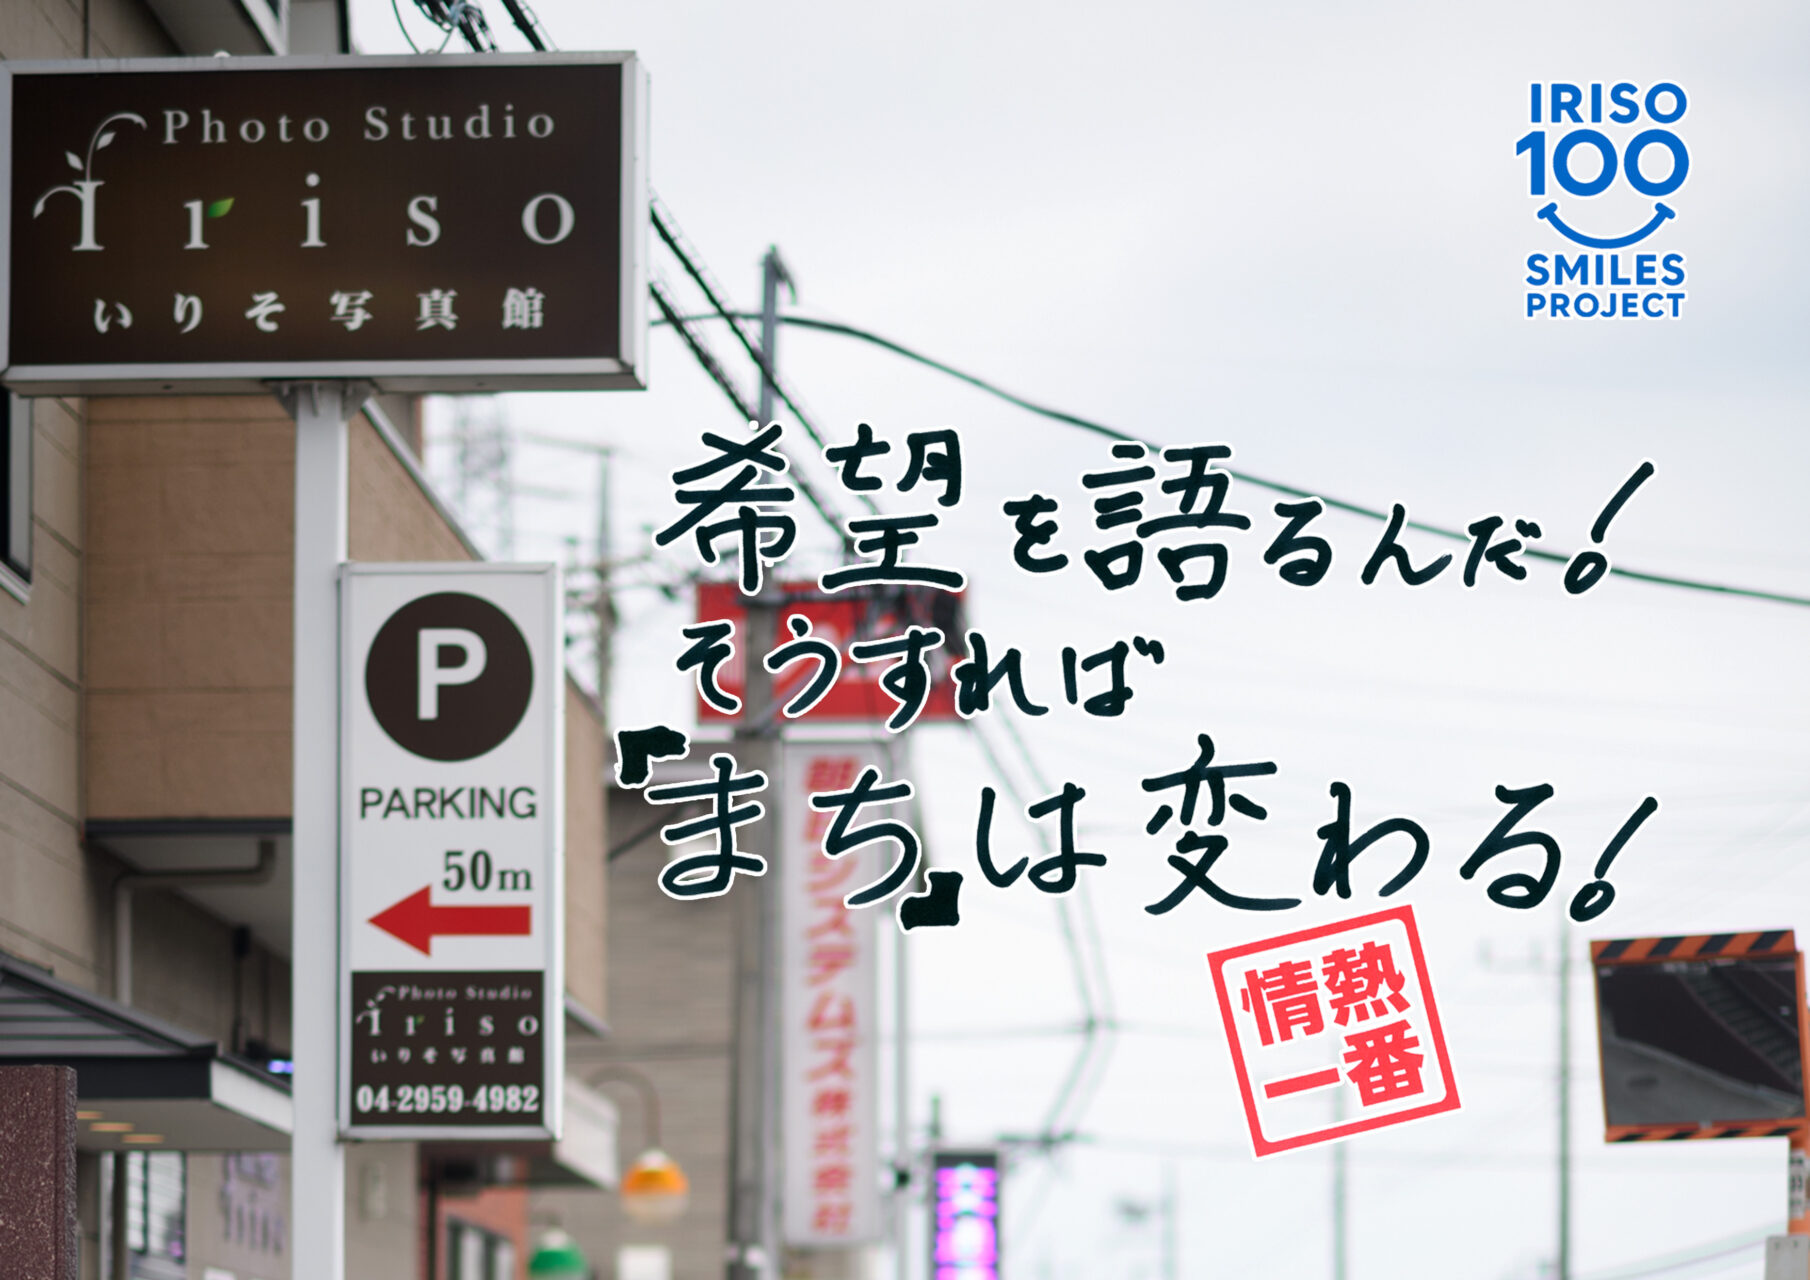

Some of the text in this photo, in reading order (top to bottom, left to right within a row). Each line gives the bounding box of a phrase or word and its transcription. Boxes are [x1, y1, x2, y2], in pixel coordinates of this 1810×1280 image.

[163, 104, 555, 144] Photo Studio
[33, 172, 576, 251] Iriso
[93, 286, 545, 334] いりそ写真館
[417, 628, 488, 720] P
[360, 786, 537, 820] PARKING
[443, 850, 532, 892] 50m
[398, 985, 532, 999] Photo Studio
[356, 1007, 540, 1036] Iriso
[356, 1084, 541, 1113] 04-2959-4982
